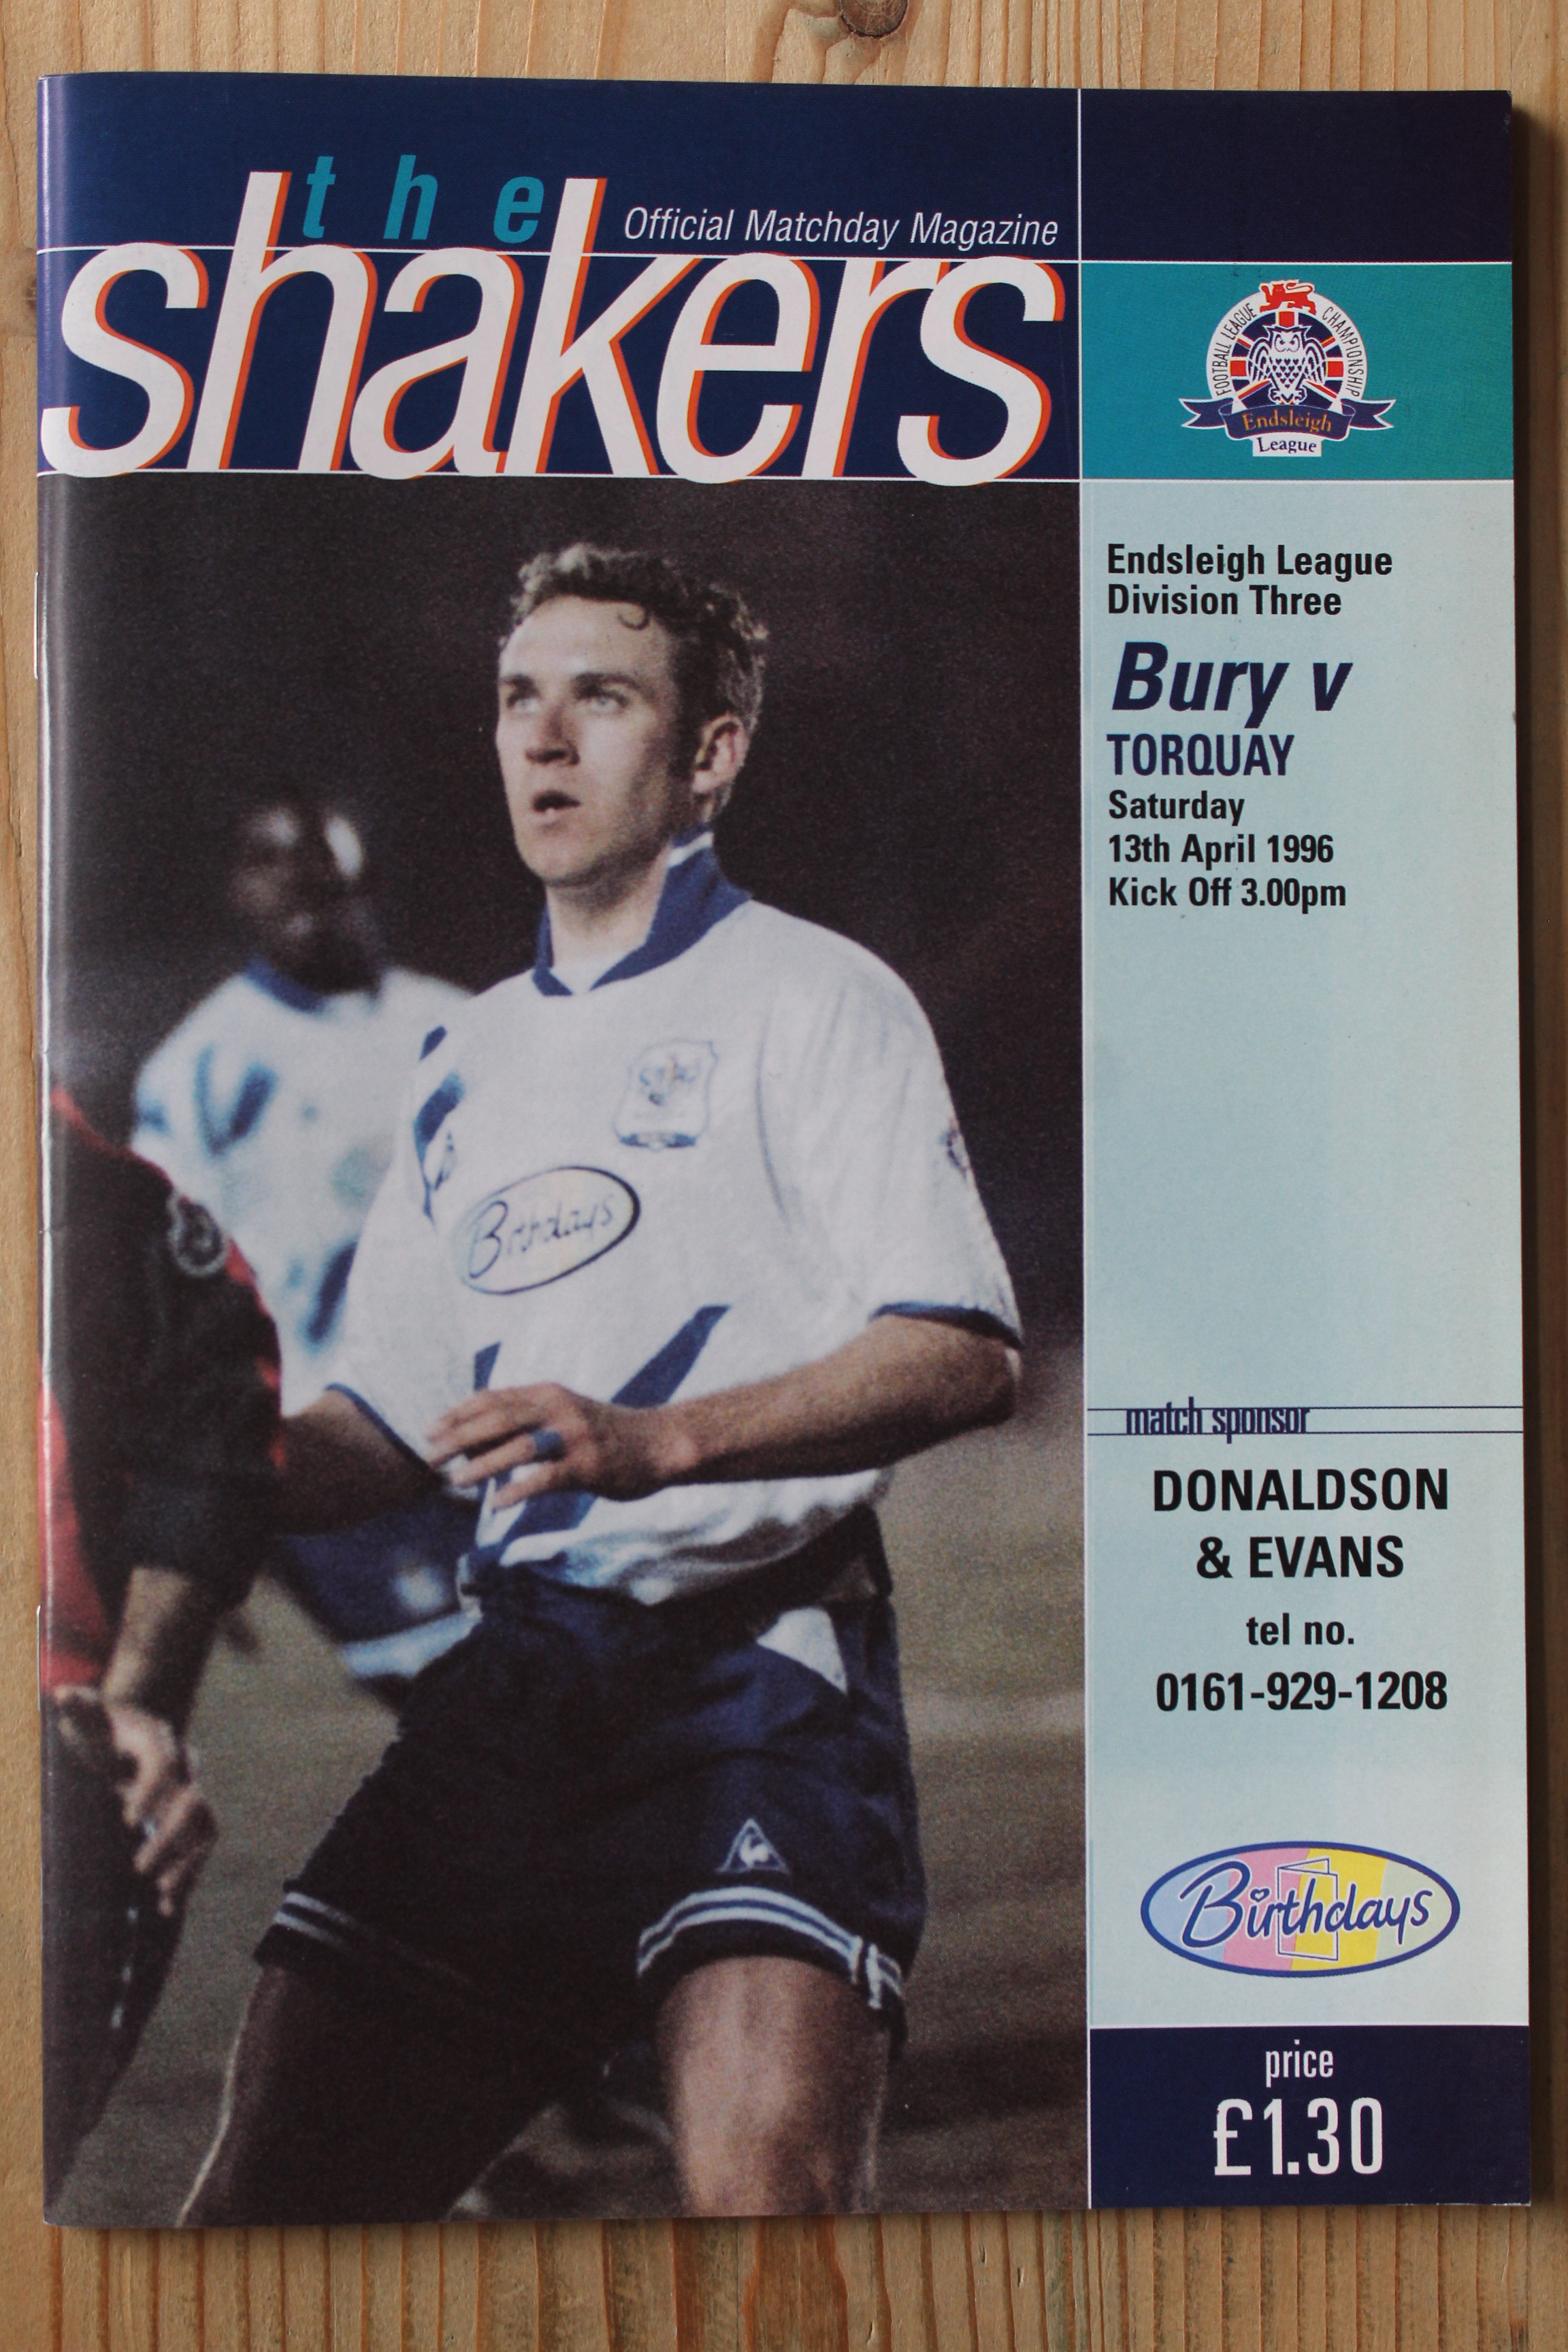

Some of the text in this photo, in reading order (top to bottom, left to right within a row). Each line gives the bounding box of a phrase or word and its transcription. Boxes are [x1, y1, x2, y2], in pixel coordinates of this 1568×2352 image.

[623, 206, 1059, 252] Official Matchday Magazine
[40, 170, 1066, 485] shakers
[1211, 302, 1258, 397] FOOTBALL LEAGUE
[1322, 306, 1365, 397] CHAMPIONSHIP
[1241, 408, 1333, 433] Endsleigh
[1256, 436, 1318, 454] League
[1107, 543, 1393, 583] Endsleigh League
[1107, 583, 1342, 616] Division Three
[1111, 640, 1354, 729] Bury v
[1106, 732, 1295, 777] TORQUAY
[1108, 788, 1245, 828] Saturday
[1108, 832, 1335, 871] 13th April 1996
[1109, 876, 1347, 915] Kick Off 3.00pm
[1126, 1396, 1311, 1445] match sponsor
[1153, 1467, 1448, 1512] DONALDSON
[1196, 1535, 1405, 1580] & EVANS
[1245, 1612, 1355, 1646] tel no.
[1156, 1670, 1448, 1712] 0161-929-1208
[1179, 1860, 1433, 1949] Birthdays
[1264, 2039, 1335, 2088] price
[1213, 2097, 1384, 2176] £1.30
